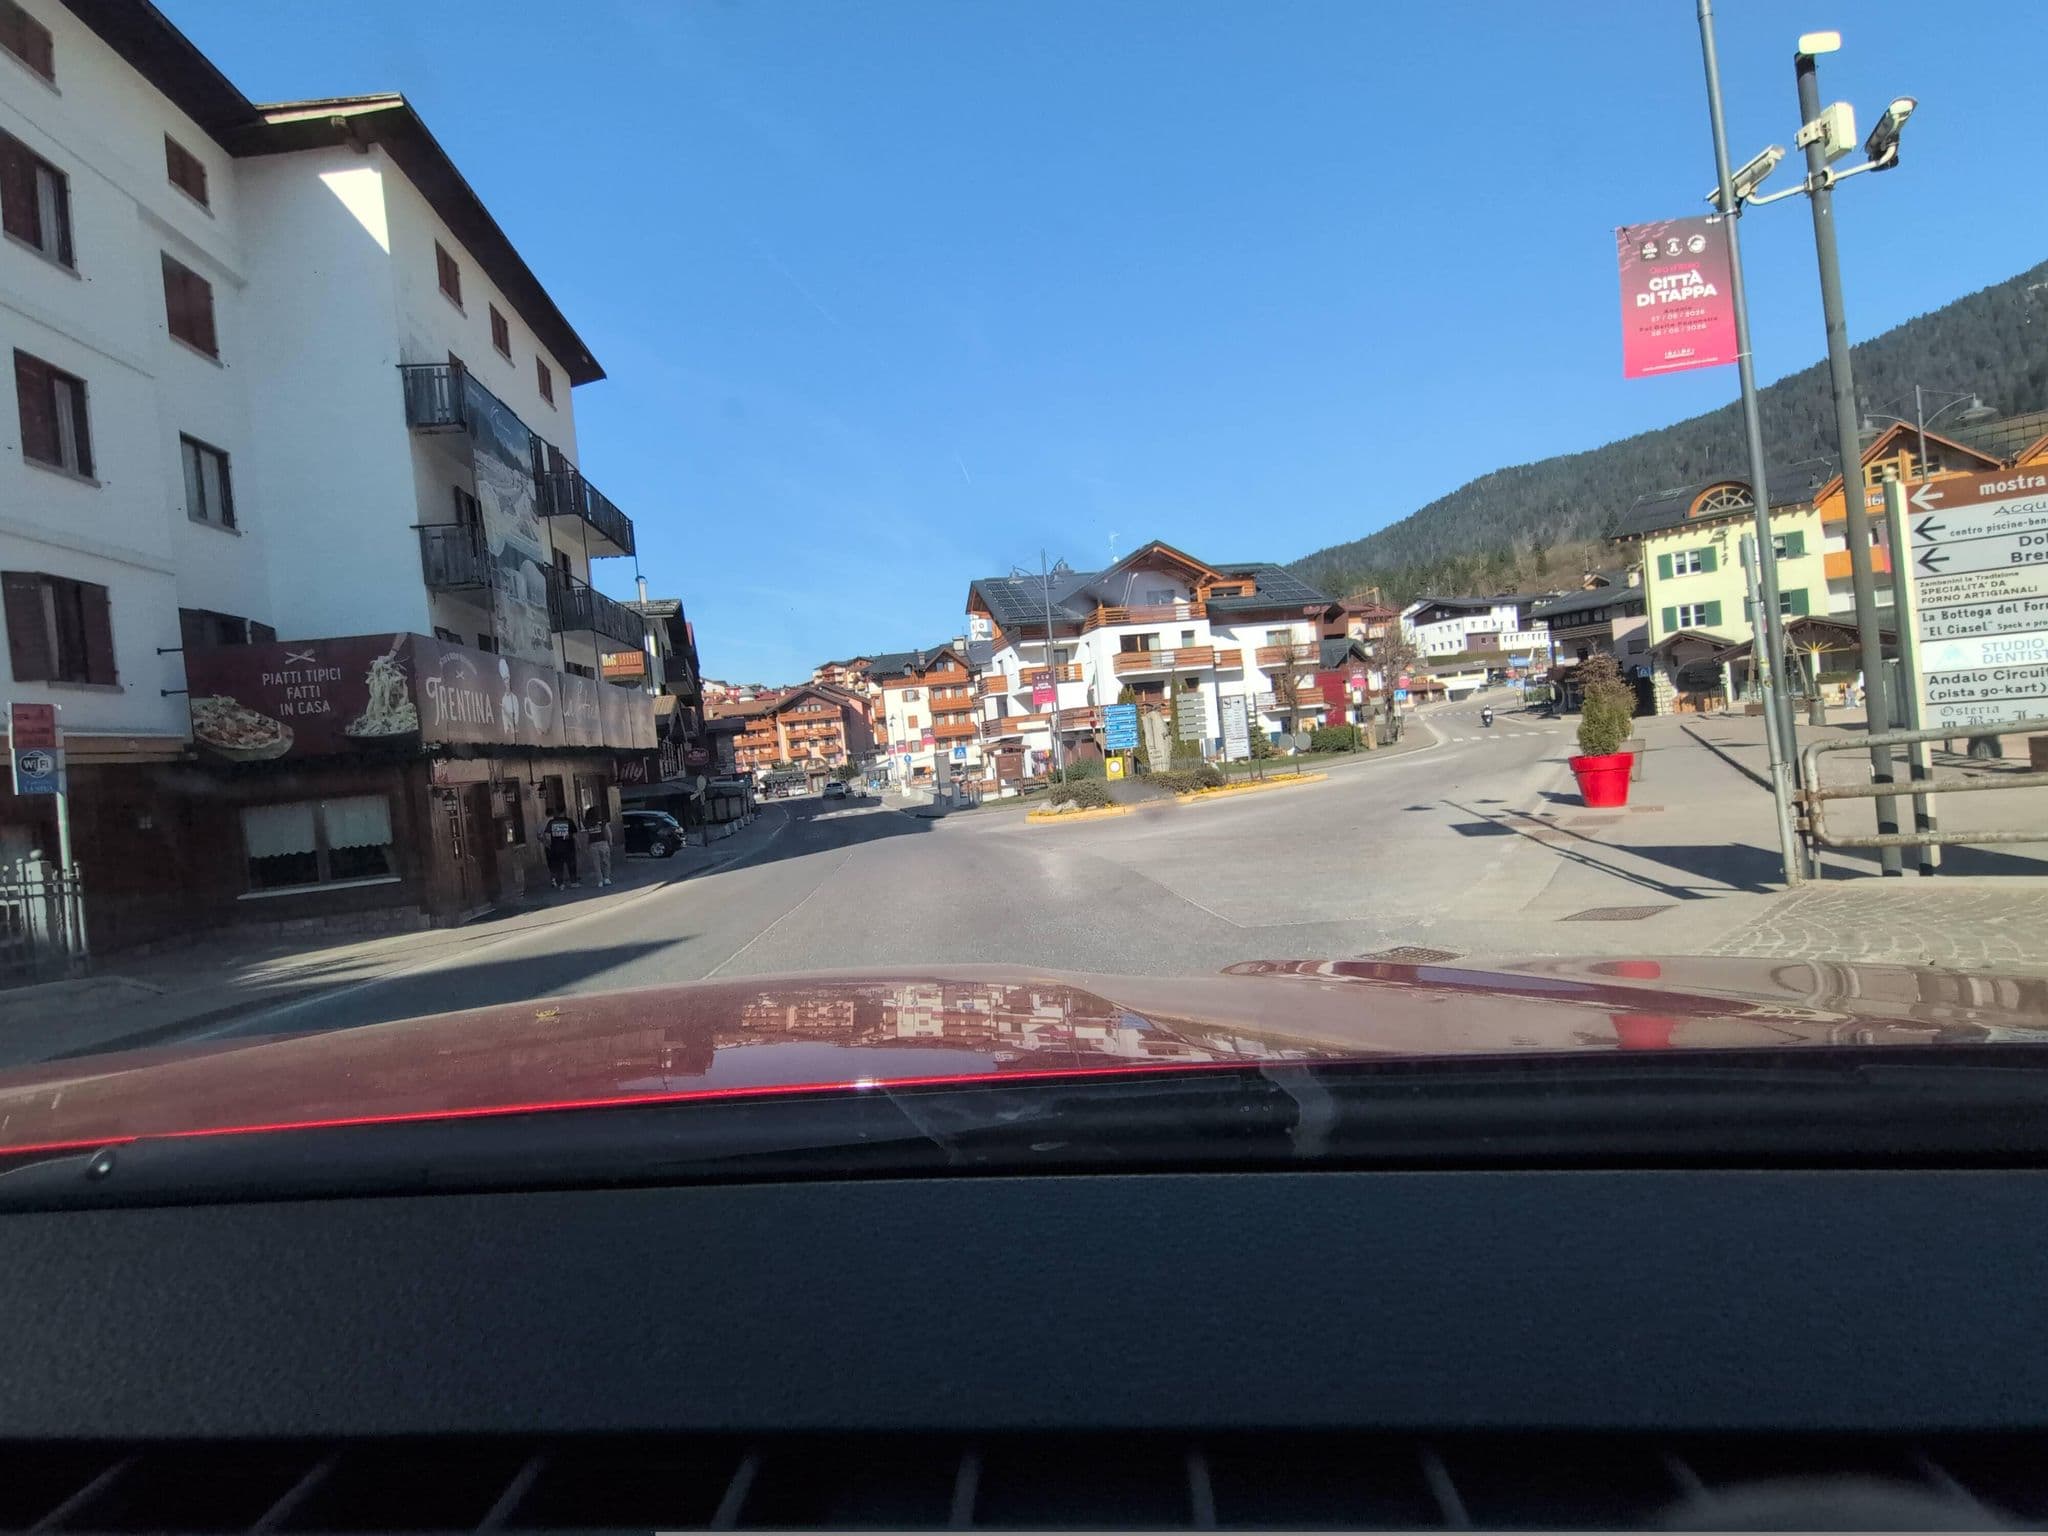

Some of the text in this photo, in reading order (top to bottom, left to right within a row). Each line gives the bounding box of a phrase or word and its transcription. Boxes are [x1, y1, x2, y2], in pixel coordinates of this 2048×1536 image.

[1649, 269, 1704, 291] CITTÀ
[1636, 283, 1718, 307] DI TAPPA
[1979, 475, 2046, 496] mostra
[1950, 517, 2048, 538] centro piscine-ben
[1990, 580, 2007, 588] DA
[1921, 585, 2038, 604] FORNO ARTIGIANALI
[1922, 612, 1936, 623] La
[1941, 606, 1993, 621] Bottega
[1997, 603, 2019, 615] del
[1981, 638, 2045, 653] STUDIO
[262, 667, 342, 686] PIATTI TIPICI
[1929, 672, 1988, 686] Andalo
[286, 685, 321, 700] FATTI
[1929, 682, 2047, 700] (pista go-kart)
[280, 700, 331, 716] IN CASA
[1940, 705, 2000, 717] Osteria
